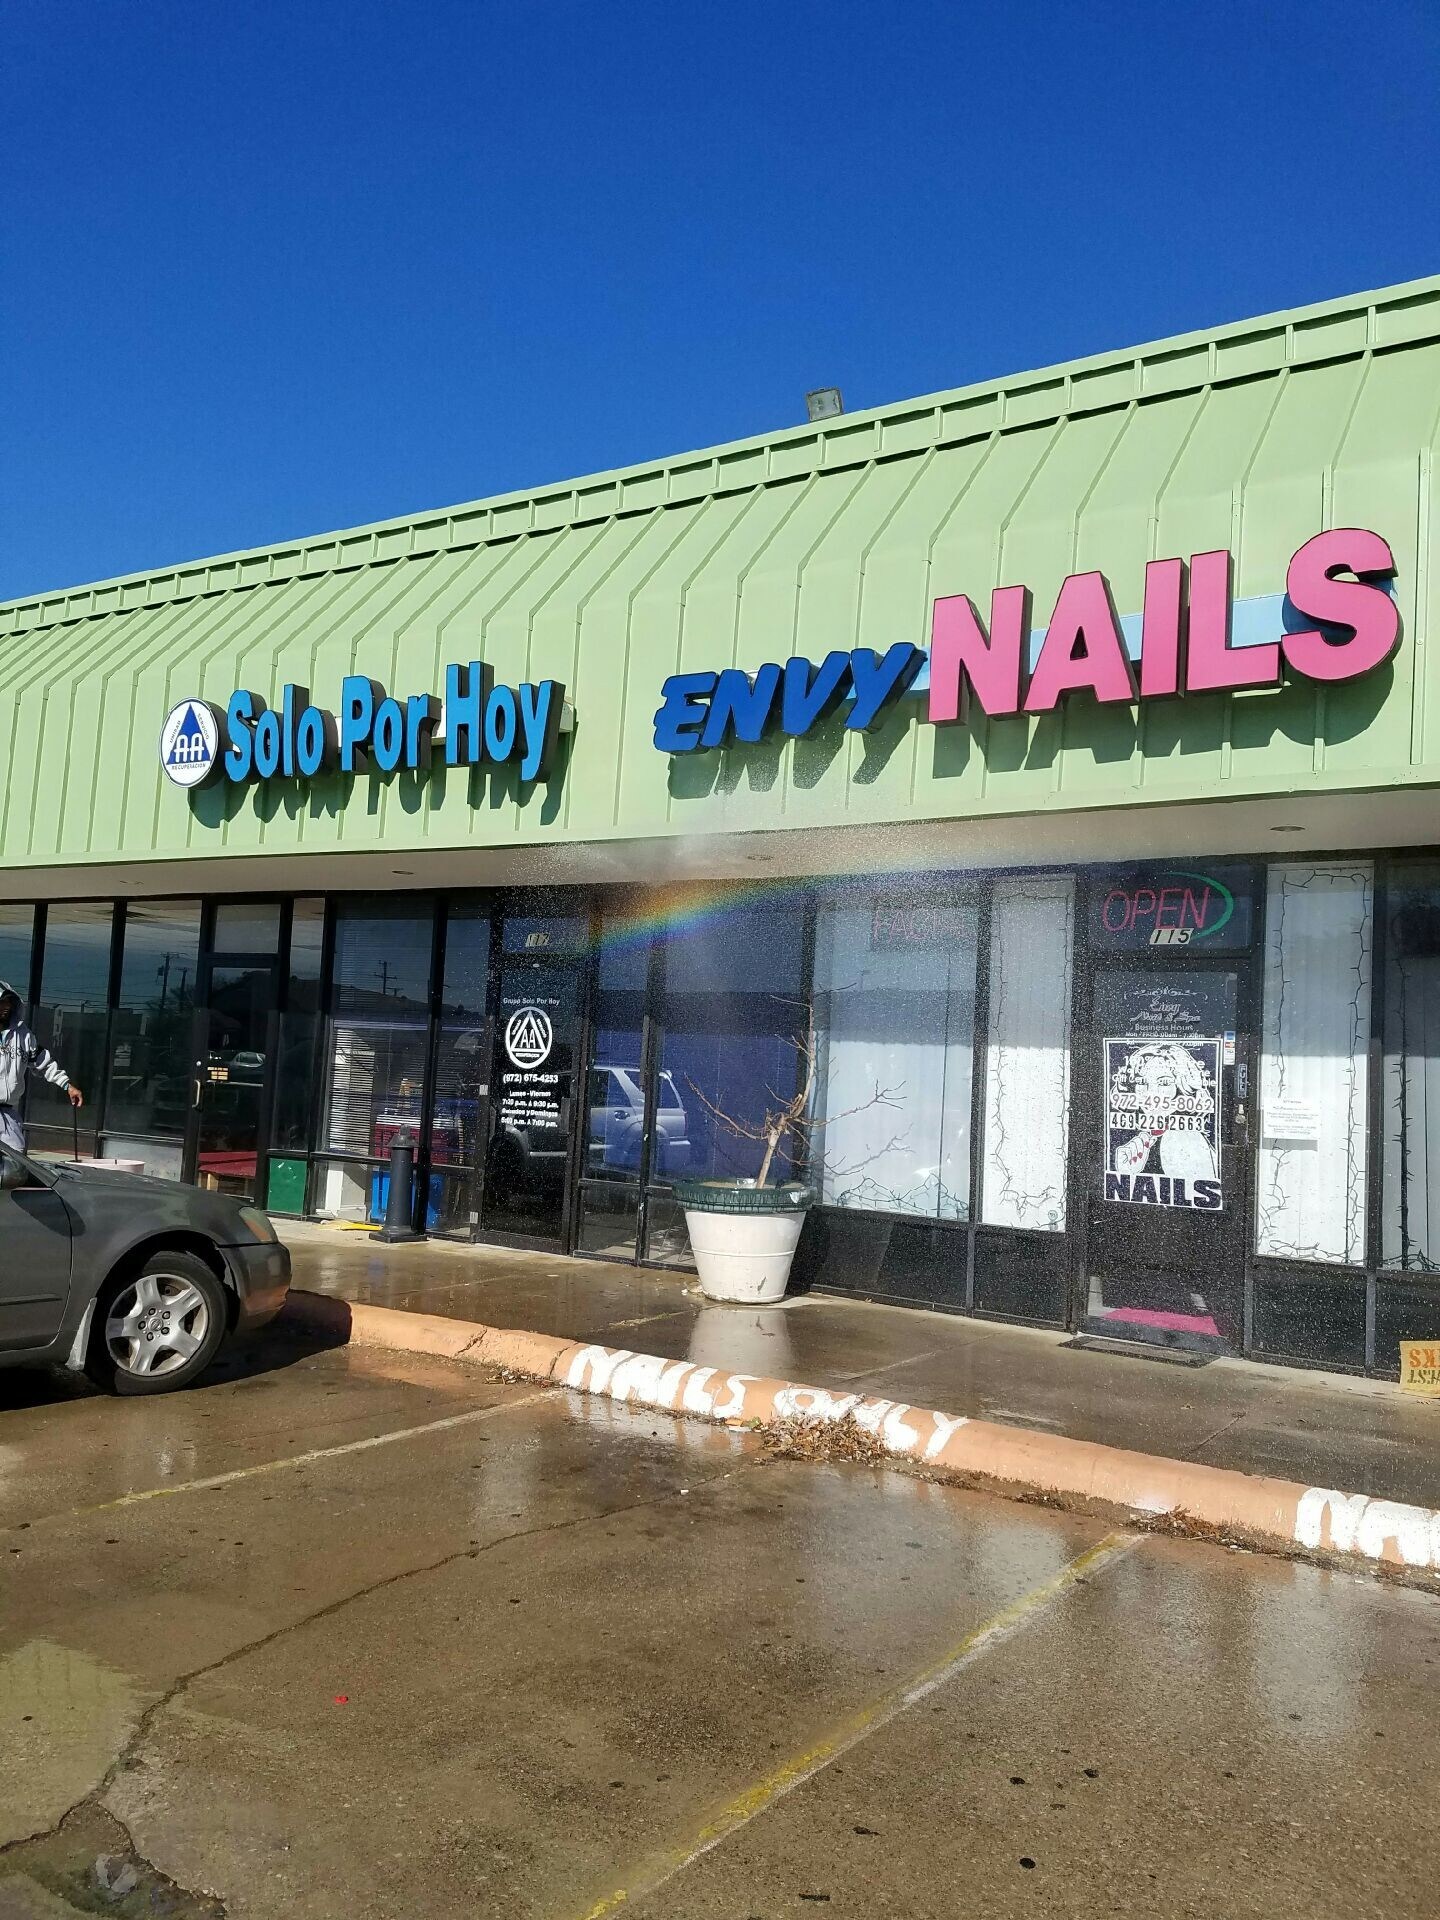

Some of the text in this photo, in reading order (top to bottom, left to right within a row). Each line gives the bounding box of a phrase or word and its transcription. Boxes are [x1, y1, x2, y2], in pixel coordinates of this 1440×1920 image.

[653, 527, 1401, 754] ENVY NAILS
[170, 720, 181, 743] UNIDAD
[198, 713, 209, 740] SERVICIO
[225, 660, 562, 783] Solo Por Hoy
[174, 733, 204, 763] AA
[1103, 886, 1210, 932] OPEN
[1153, 930, 1191, 943] 115
[503, 997, 521, 1006] Grupo
[548, 998, 560, 1006] Hoy
[520, 1029, 536, 1048] AA
[1135, 1023, 1193, 1031] Business Hours
[503, 1073, 558, 1084] (972) 675-4253
[1112, 1114, 1202, 1131] 469 226 2663
[1105, 1173, 1222, 1208] NAILS
[1409, 1348, 1440, 1368] KS
[567, 1344, 969, 1460] NAILS ONLY
